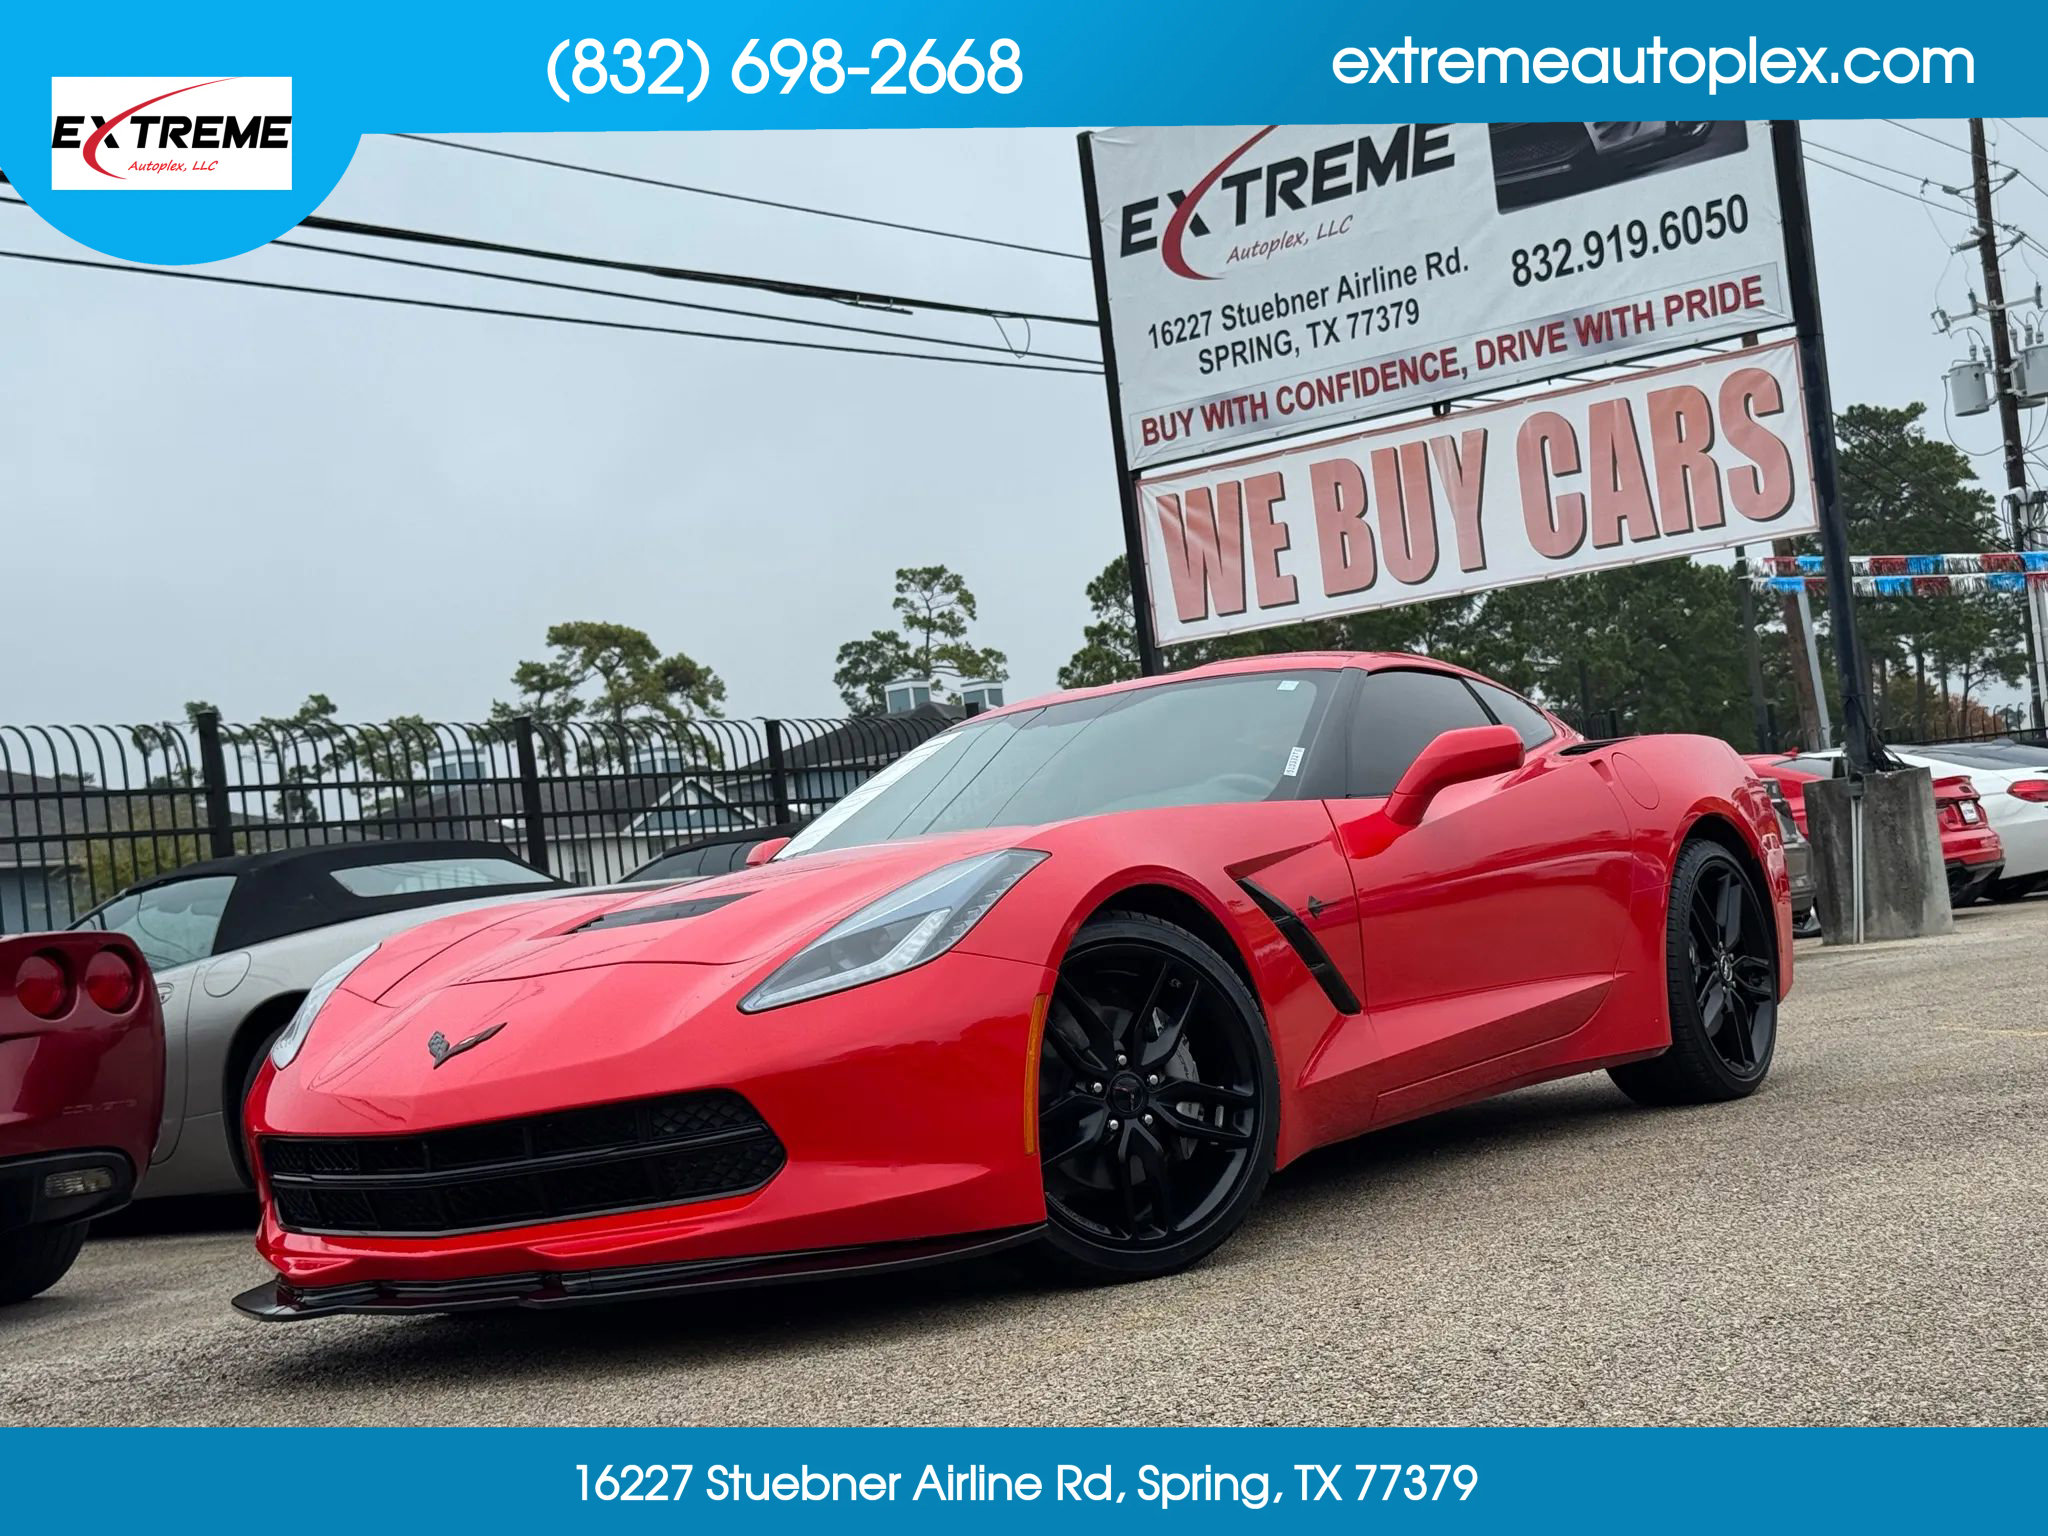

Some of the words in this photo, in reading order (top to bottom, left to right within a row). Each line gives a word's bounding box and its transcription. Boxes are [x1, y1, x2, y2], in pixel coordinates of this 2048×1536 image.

[1120, 123, 1456, 258] EXTREME
[1226, 230, 1309, 264] Autoplex,
[1316, 214, 1353, 240] LLC
[1511, 194, 1749, 288] 832.919.6050
[1148, 310, 1213, 349] 16227
[1220, 286, 1330, 332] Stuebner
[1337, 264, 1418, 304] Airline
[1425, 246, 1470, 281] Rd.
[1199, 329, 1301, 375] SPRING,
[1306, 316, 1342, 350] TX
[1347, 298, 1420, 340] 77379
[1142, 407, 1195, 446] BUY
[1200, 391, 1269, 433] WITH
[1276, 346, 1469, 416] CONFIDENCE,
[1476, 320, 1569, 370] DRIVE
[1573, 300, 1656, 347] WITH
[1664, 275, 1766, 327] PRIDE
[1156, 471, 1301, 624] WE
[1310, 428, 1490, 599] BUY
[1516, 367, 1796, 562] CARS
